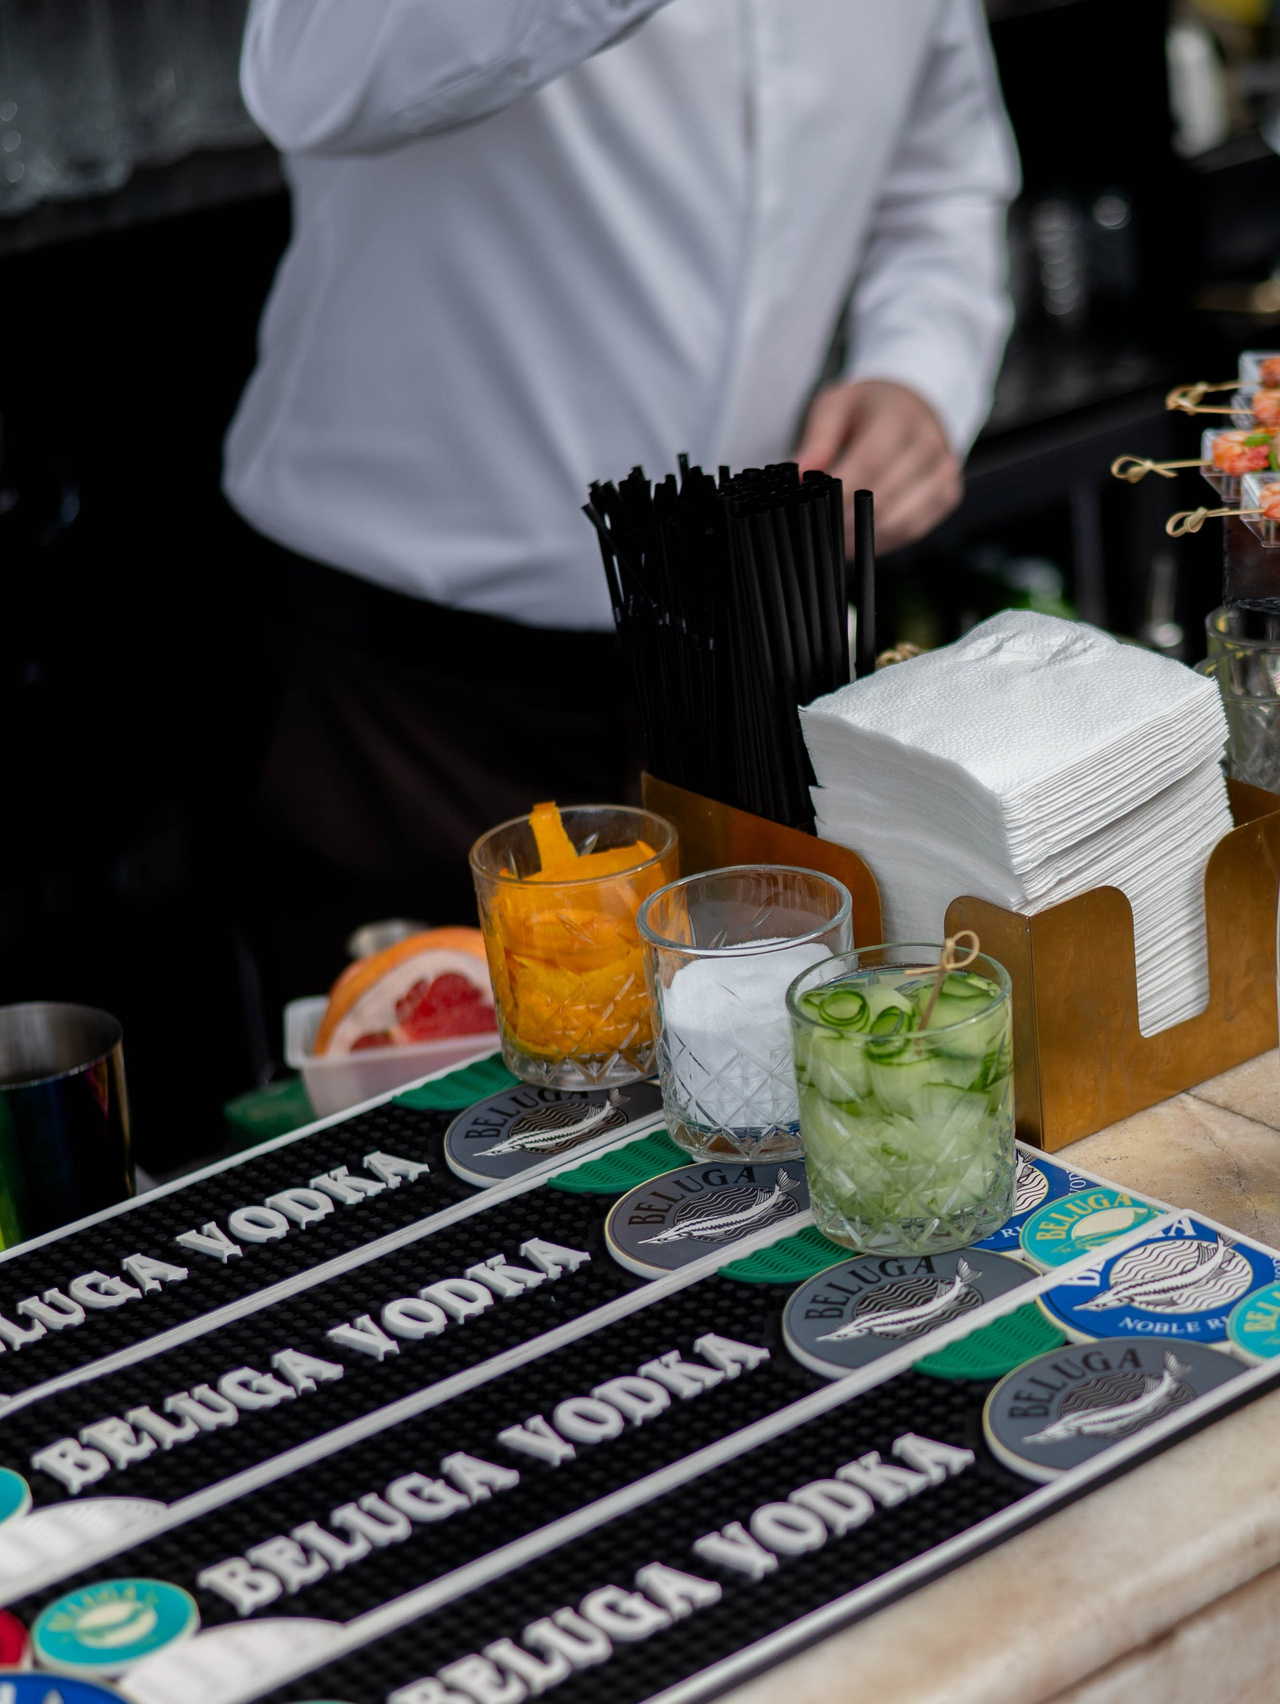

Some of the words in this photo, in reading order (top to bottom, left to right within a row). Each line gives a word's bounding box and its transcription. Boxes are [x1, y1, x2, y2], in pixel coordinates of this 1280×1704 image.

[628, 1165, 757, 1227] BELUGA
[1035, 1193, 1133, 1241] BELUGA
[0, 1253, 189, 1352] LUGA
[176, 1150, 430, 1264] VODKA
[804, 1256, 937, 1321] BELUGA
[1118, 1316, 1200, 1334] NOBLE
[31, 1347, 345, 1494] BELUGA
[328, 1237, 592, 1361] VODKA
[1008, 1347, 1143, 1420] BELUGA
[197, 1451, 520, 1616] BELUGA
[497, 1332, 771, 1466] VODKA
[693, 1432, 975, 1580] VODKA
